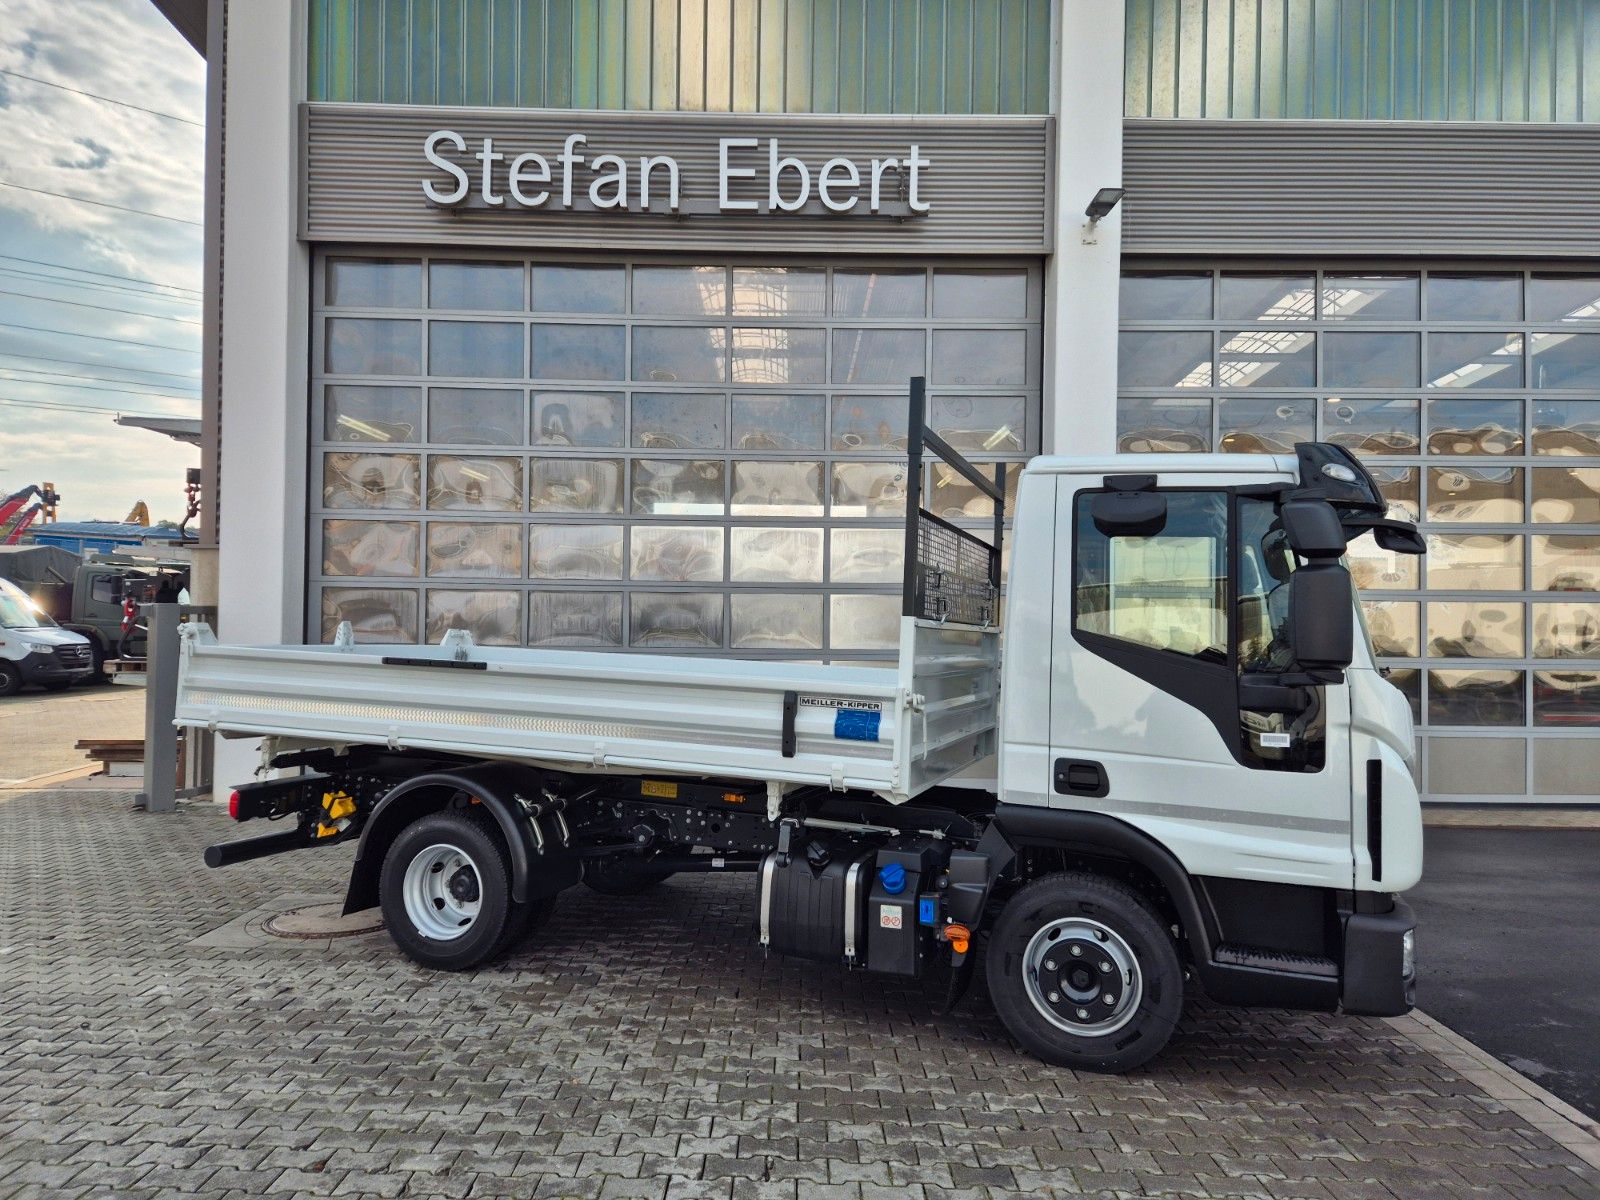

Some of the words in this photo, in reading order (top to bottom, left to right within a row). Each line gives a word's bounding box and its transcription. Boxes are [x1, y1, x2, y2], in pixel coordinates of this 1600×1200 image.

[421, 130, 681, 213] Stefan
[719, 137, 931, 214] Ebert
[801, 698, 880, 710] MEILLER-KIPPER
